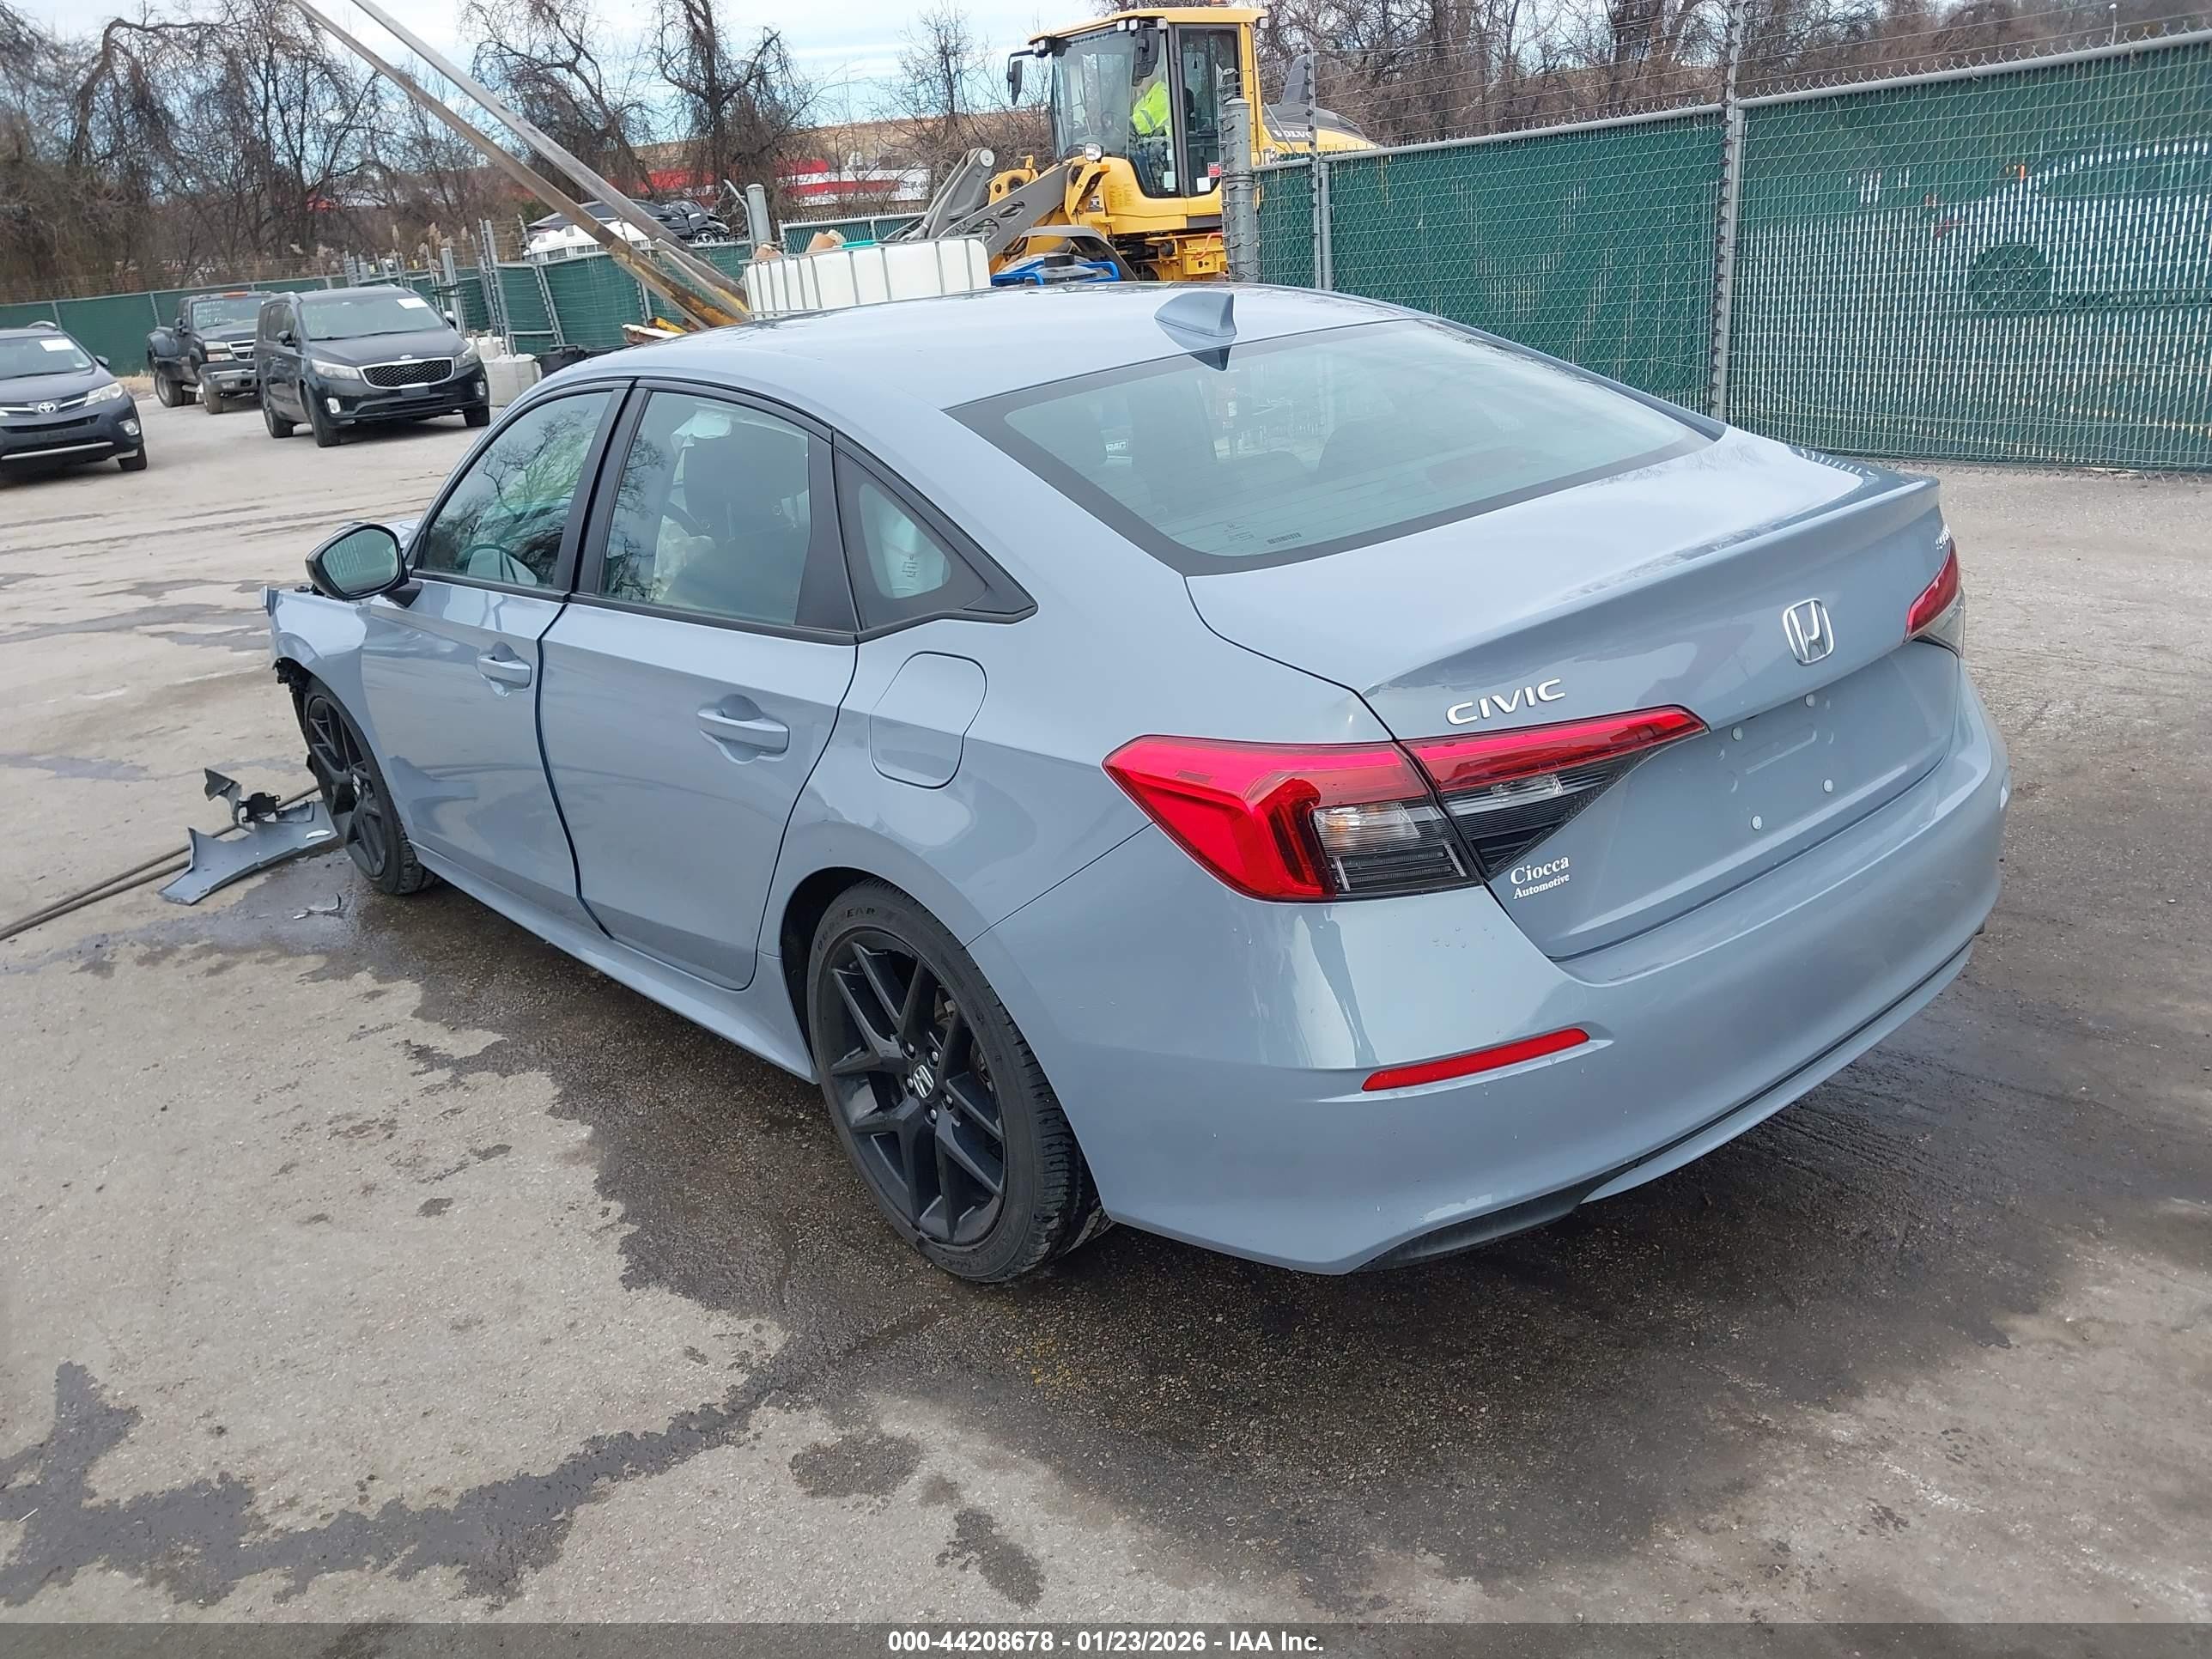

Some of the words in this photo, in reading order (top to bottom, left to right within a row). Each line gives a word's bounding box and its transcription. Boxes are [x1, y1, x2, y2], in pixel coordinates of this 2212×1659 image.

[1271, 130, 1313, 138] VOLVO
[1445, 678, 1566, 726] CIVIC
[1510, 855, 1571, 885] Ciocca
[1512, 874, 1571, 900] Automotive
